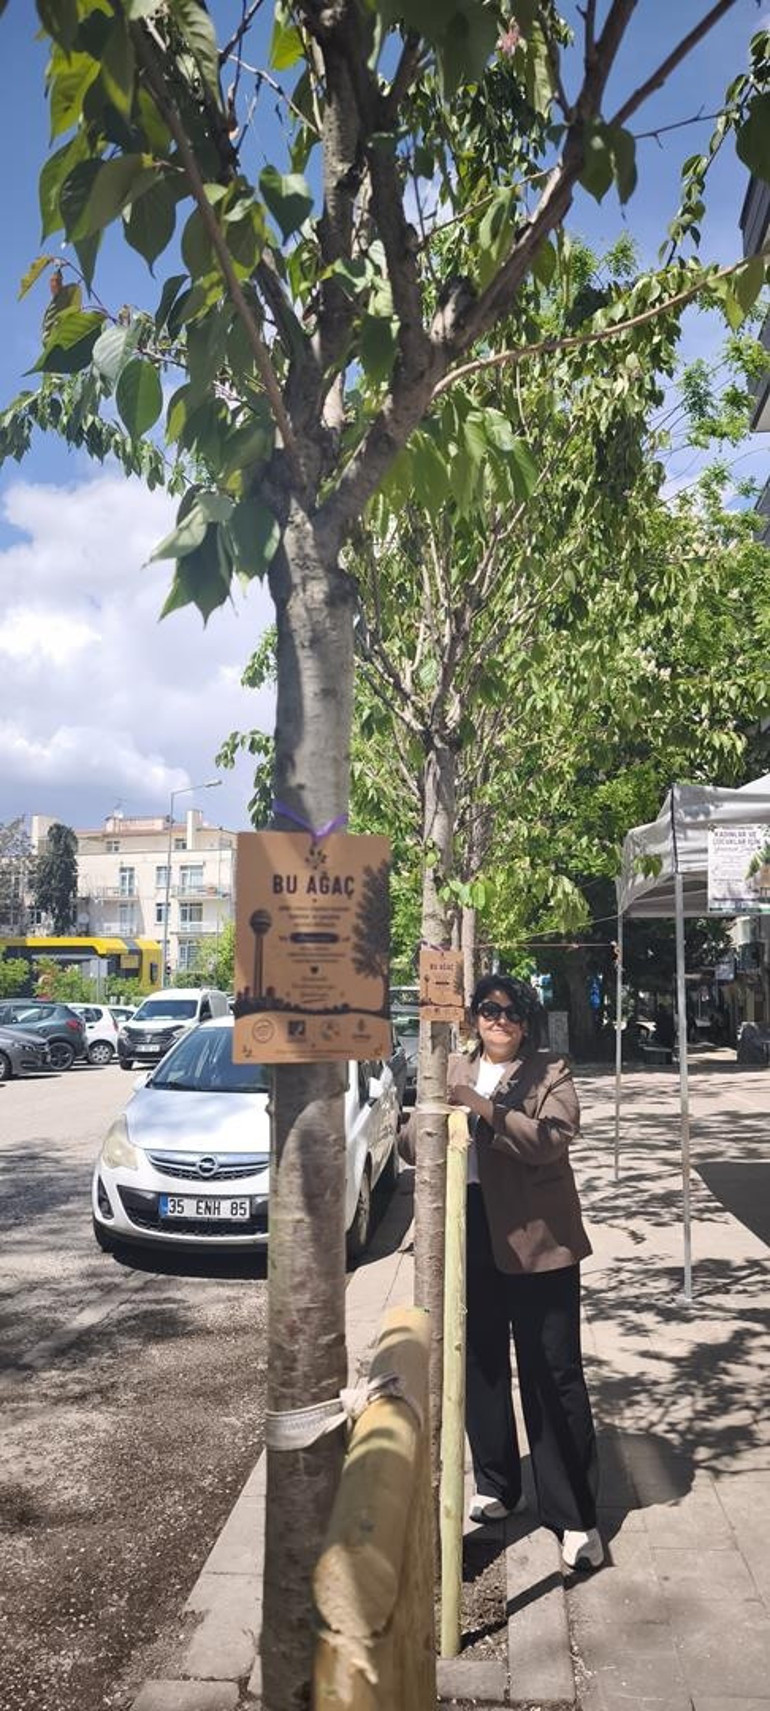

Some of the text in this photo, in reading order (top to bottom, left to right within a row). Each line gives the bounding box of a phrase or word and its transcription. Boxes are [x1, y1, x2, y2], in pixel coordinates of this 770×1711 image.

[273, 870, 355, 899] BU AĞAÇ
[168, 1198, 247, 1216] 35 ENH 85
